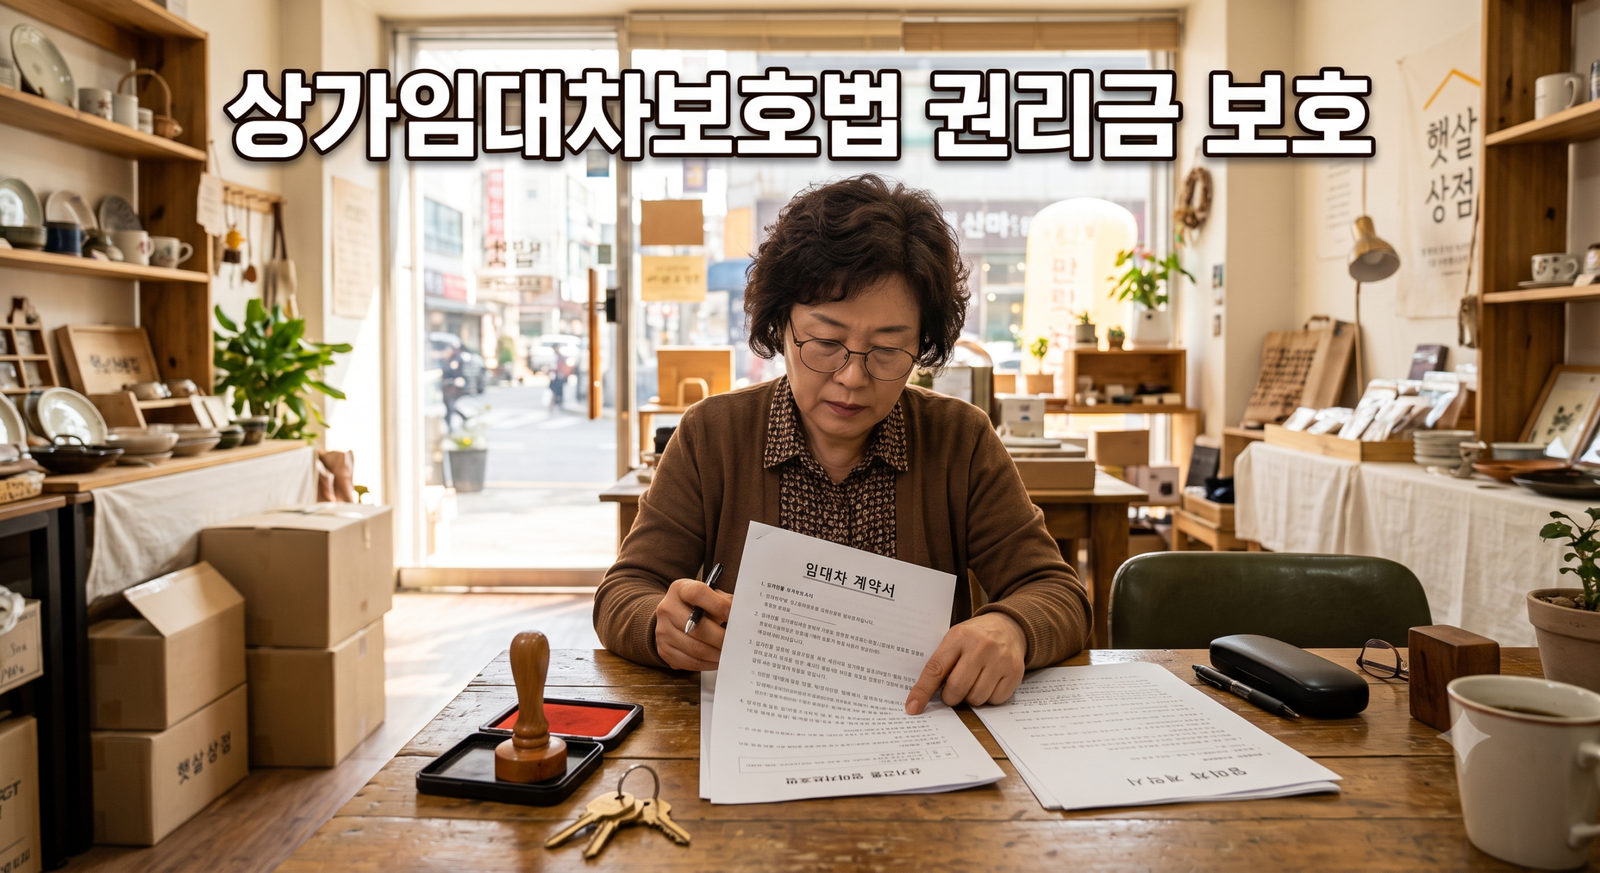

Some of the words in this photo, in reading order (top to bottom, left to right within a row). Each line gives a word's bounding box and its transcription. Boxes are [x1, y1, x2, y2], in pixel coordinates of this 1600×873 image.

[1427, 106, 1478, 168] 햇살
[1425, 167, 1474, 224] 상점
[806, 562, 848, 585] 임대차
[853, 575, 896, 598] 계약서
